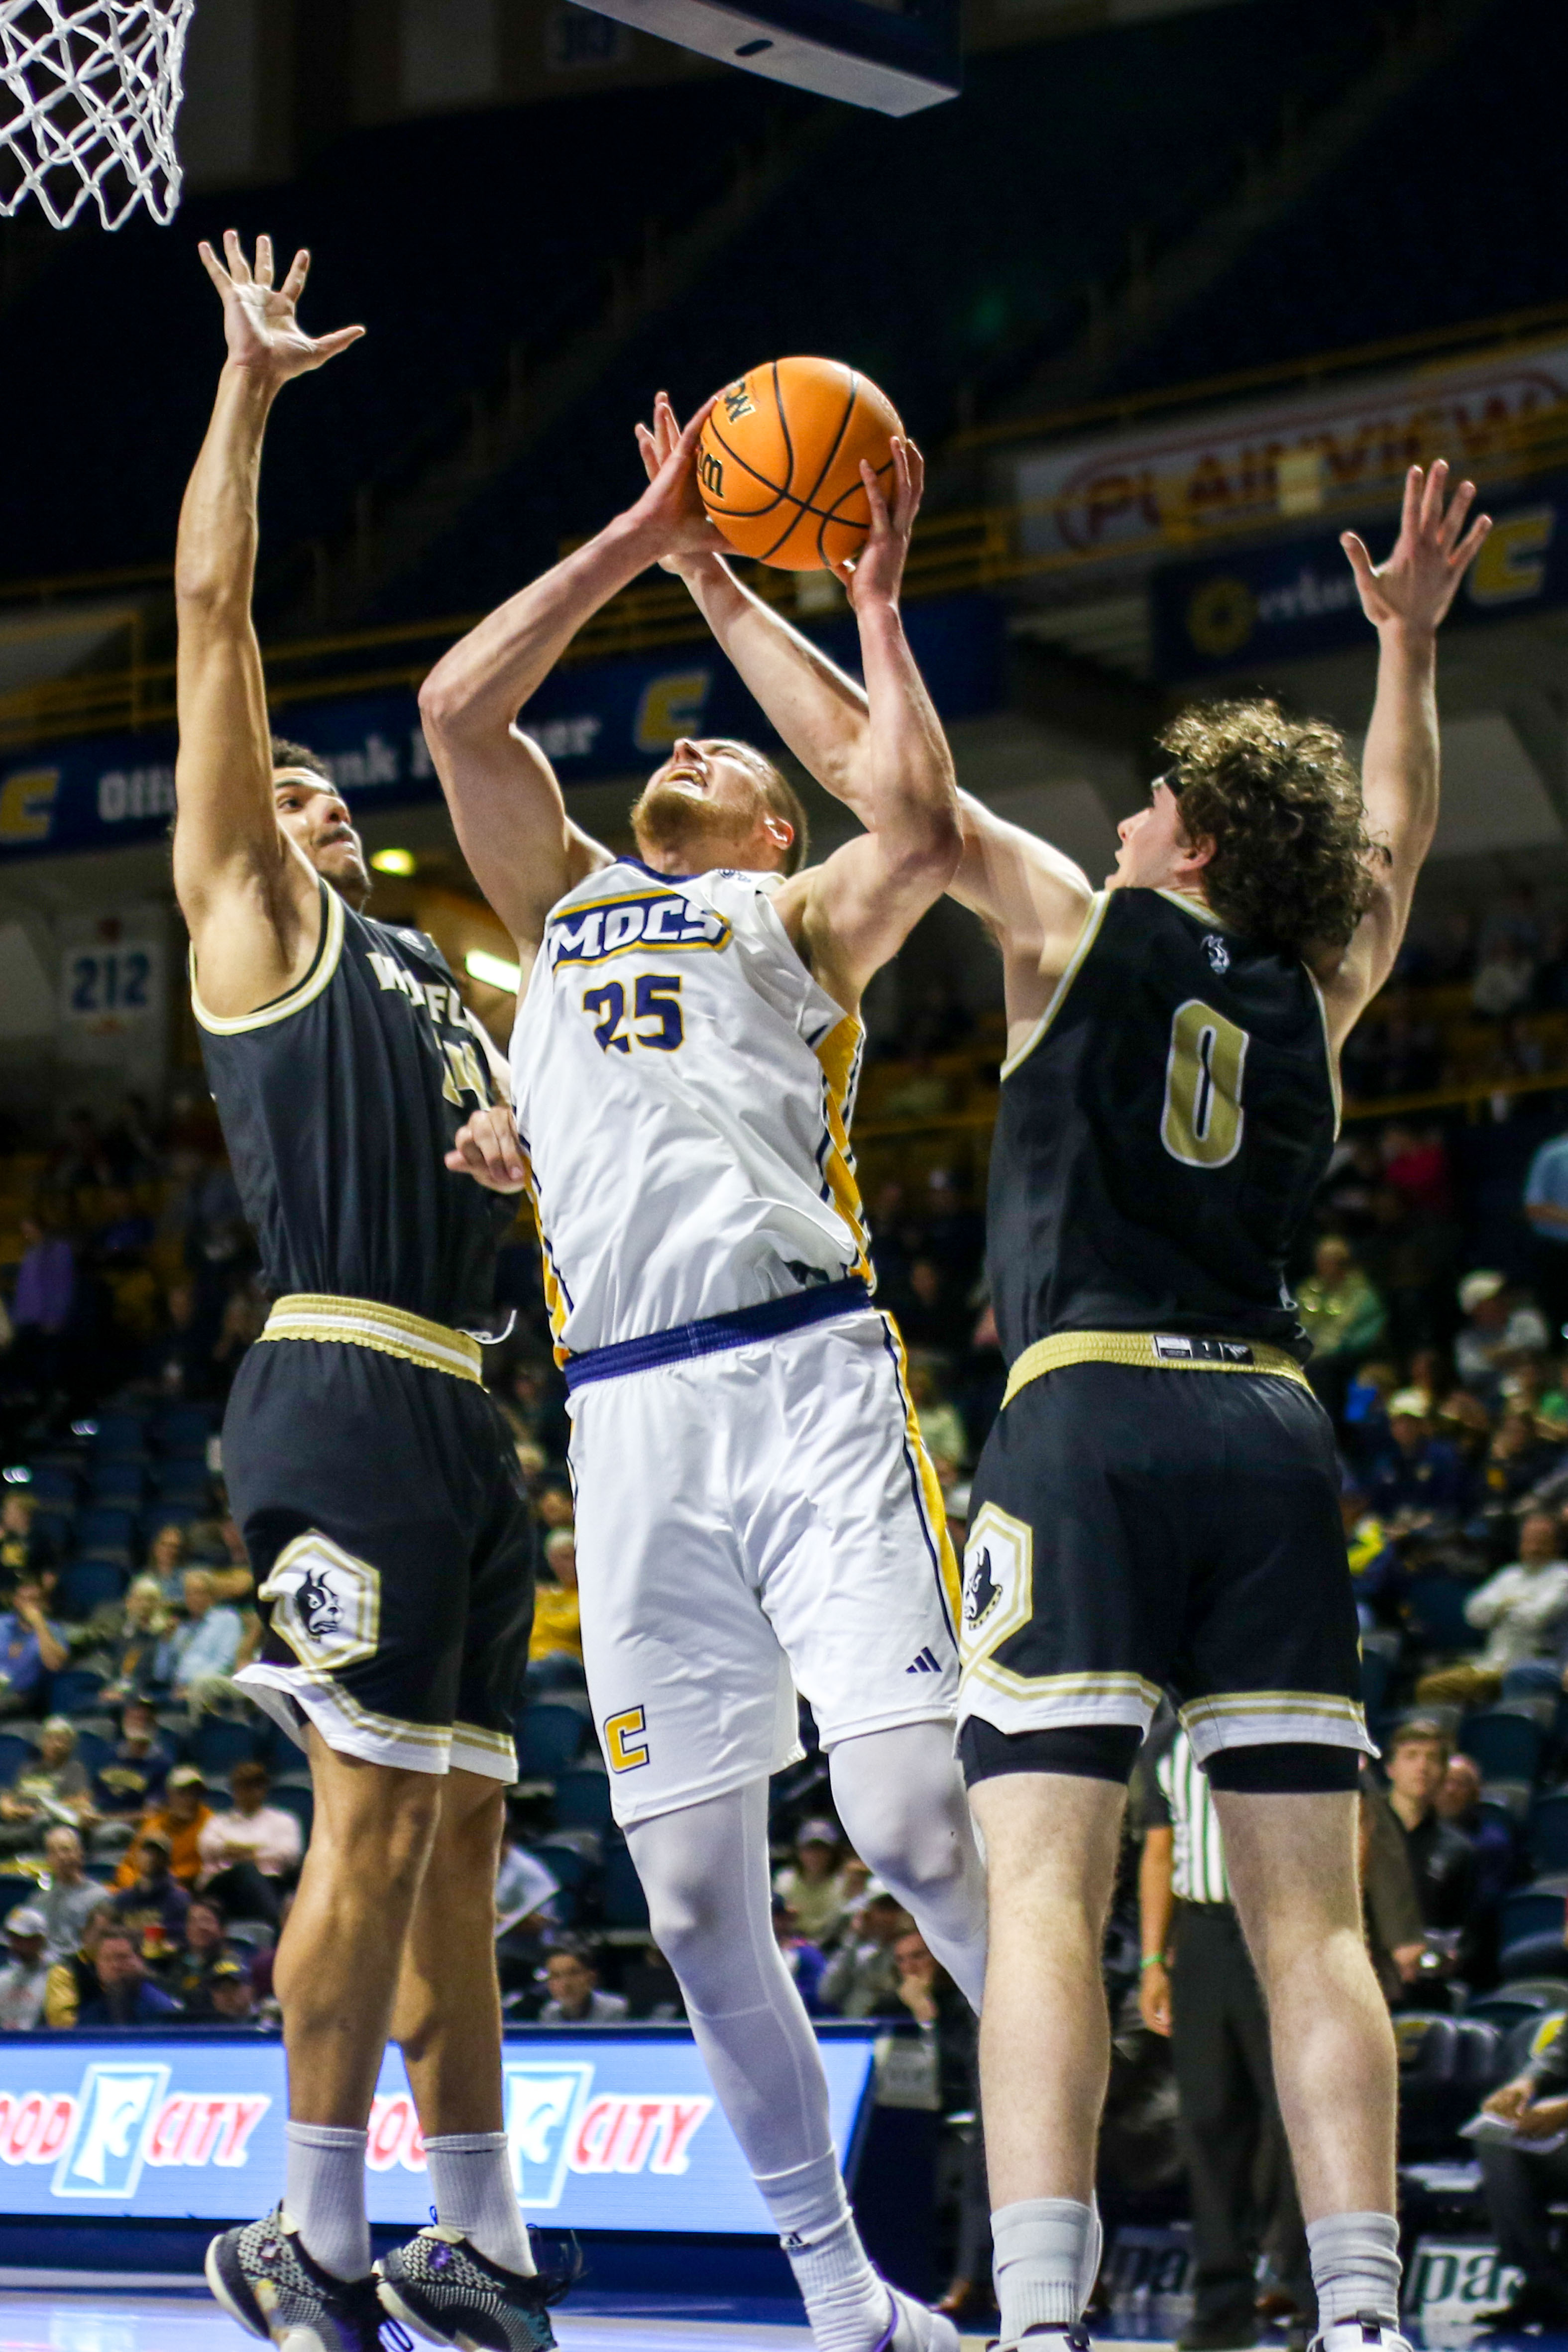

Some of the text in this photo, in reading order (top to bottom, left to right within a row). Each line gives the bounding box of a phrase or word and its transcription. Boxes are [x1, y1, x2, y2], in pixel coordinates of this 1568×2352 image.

[548, 898, 725, 964] MOCS
[73, 952, 151, 1011] 212
[581, 972, 685, 1055] 25
[1160, 999, 1249, 1168] 0
[603, 1704, 650, 1775] C
[143, 2094, 270, 2165] CITY
[569, 2096, 712, 2172] CITY
